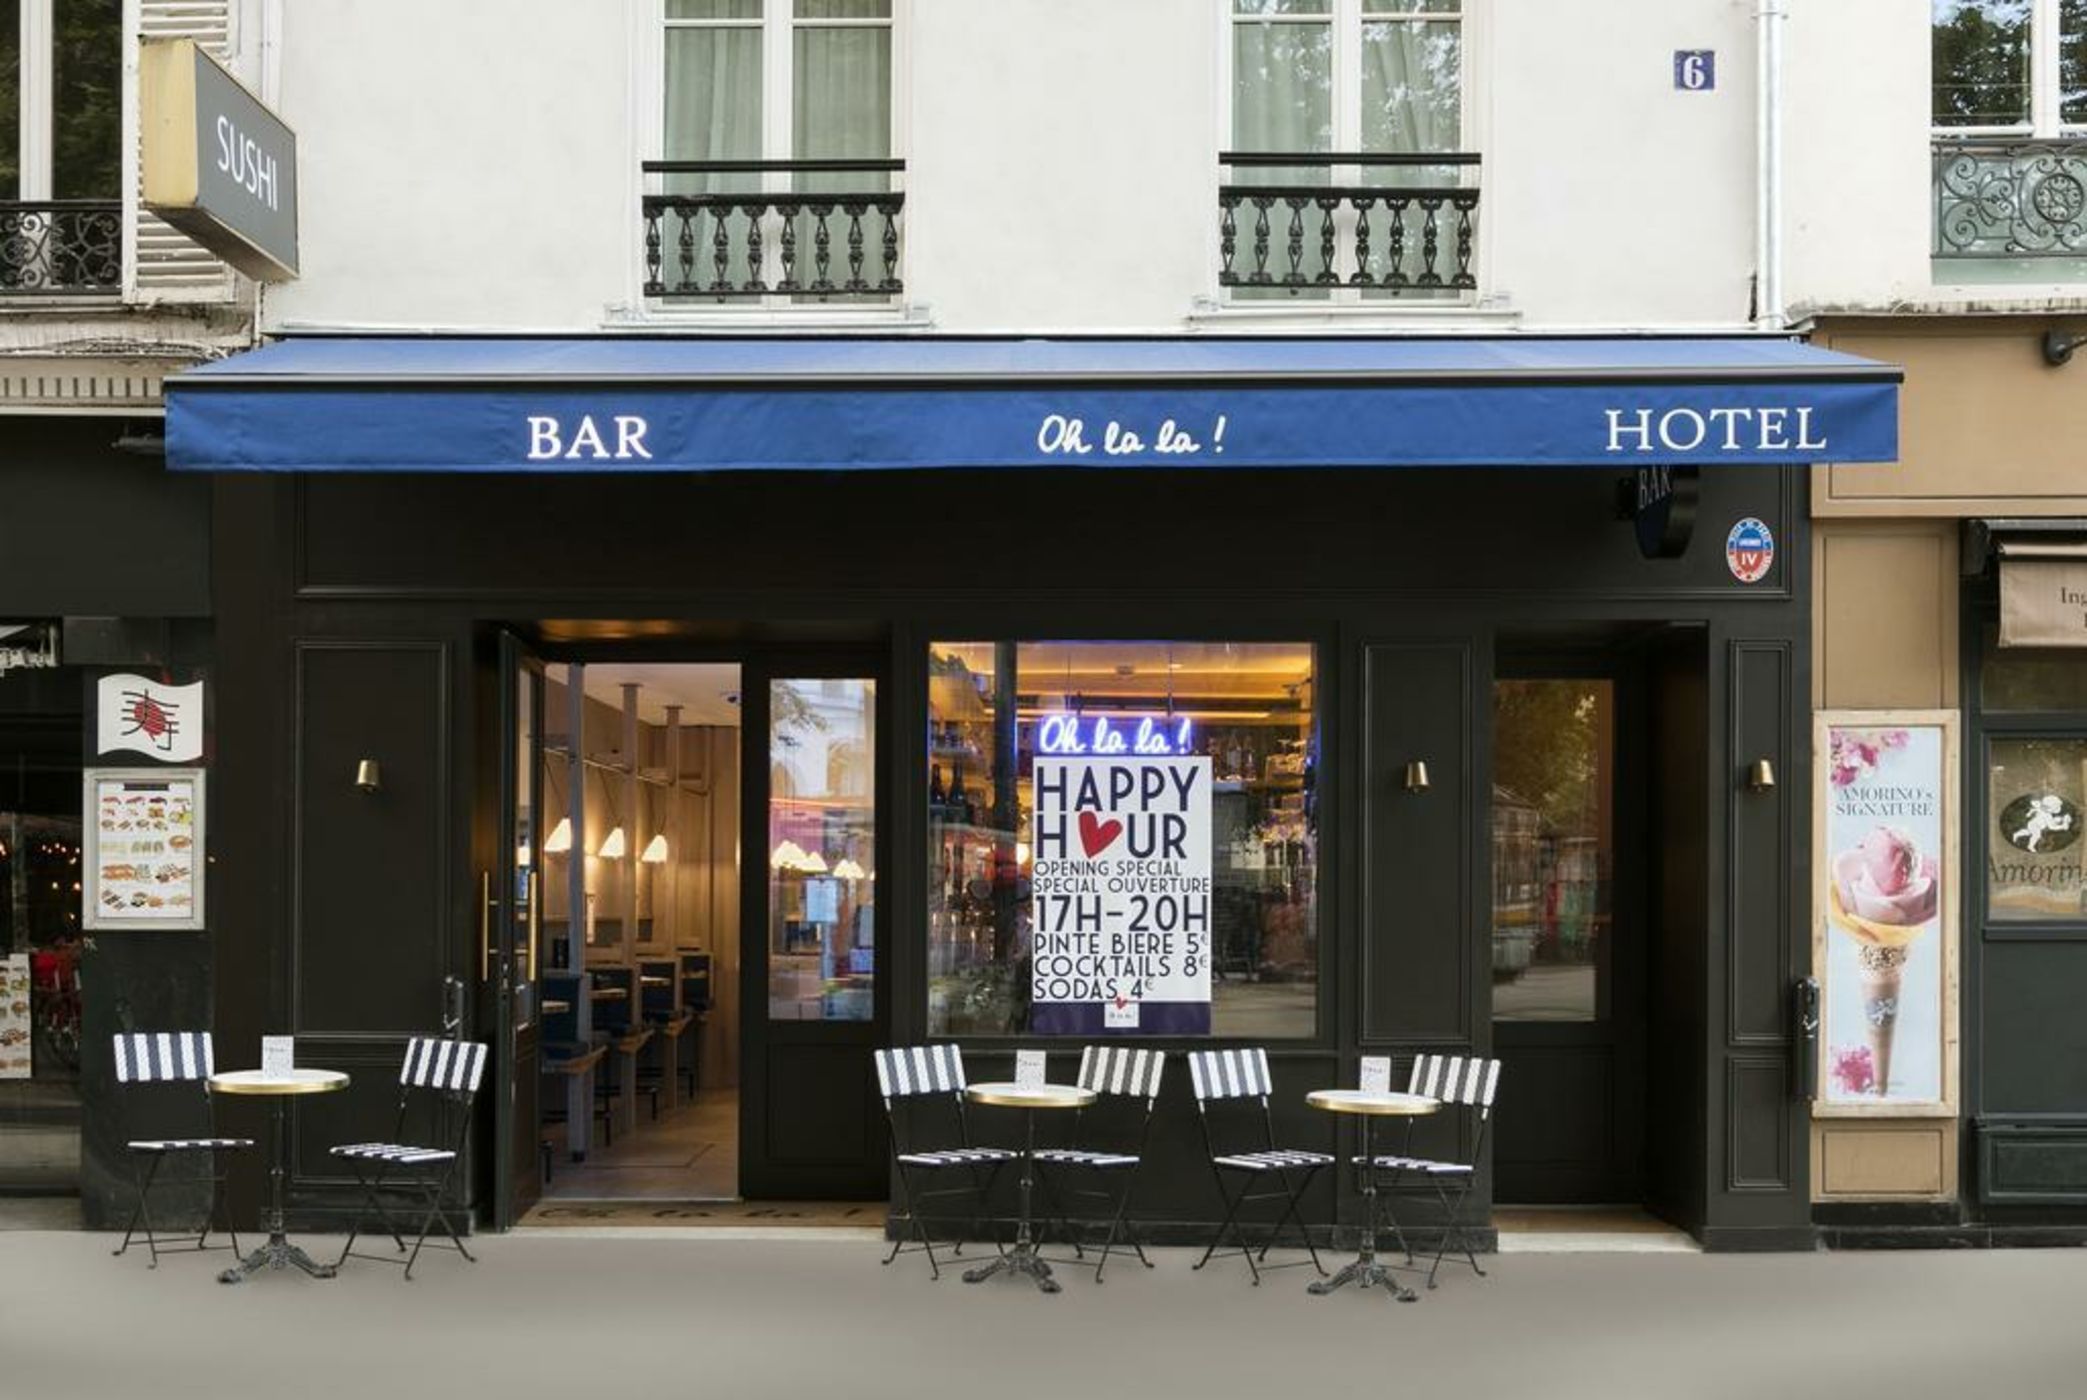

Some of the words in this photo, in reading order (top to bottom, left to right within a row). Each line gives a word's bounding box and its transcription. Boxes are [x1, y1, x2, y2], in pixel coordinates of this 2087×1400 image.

[1683, 56, 1705, 89] 6
[217, 114, 278, 212] SUSHI
[527, 414, 653, 459] BAR
[1037, 414, 1093, 454] Oh
[1104, 421, 1145, 455] la
[1155, 419, 1201, 454] la
[1605, 406, 1828, 451] HOTEL
[1741, 552, 1758, 566] IV
[1039, 716, 1086, 754] Oh
[1092, 716, 1128, 754] la
[1134, 716, 1171, 754] la
[1036, 765, 1199, 812] HAPPY
[1836, 802, 1934, 816] SIGNATURE
[1034, 860, 1109, 877] OPENING
[1116, 860, 1182, 877] SPECIAL
[1034, 877, 1099, 893] SPECIAL
[1108, 877, 1210, 893] OUVERTURE
[1036, 894, 1208, 932] 17H-20H
[1035, 932, 1100, 954] PINTE
[1112, 932, 1174, 954] BIERE
[1034, 955, 1171, 977] COCKTAILS
[1034, 978, 1118, 1000] SODAS
